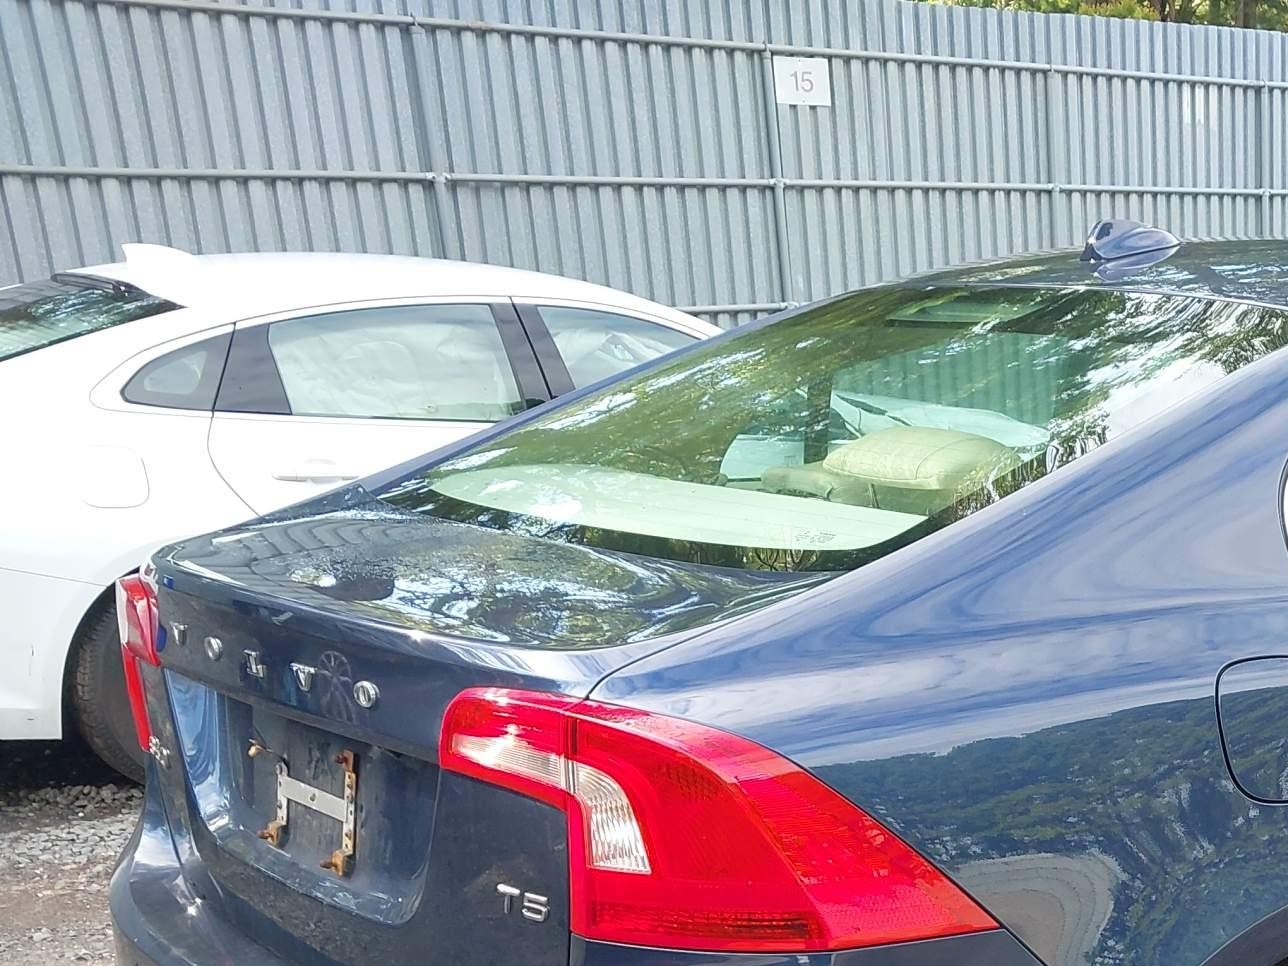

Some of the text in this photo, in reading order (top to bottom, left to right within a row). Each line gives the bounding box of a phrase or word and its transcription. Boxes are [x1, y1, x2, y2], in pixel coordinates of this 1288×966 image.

[790, 71, 814, 92] 15
[169, 621, 381, 709] VOLVO
[496, 883, 550, 922] T5
